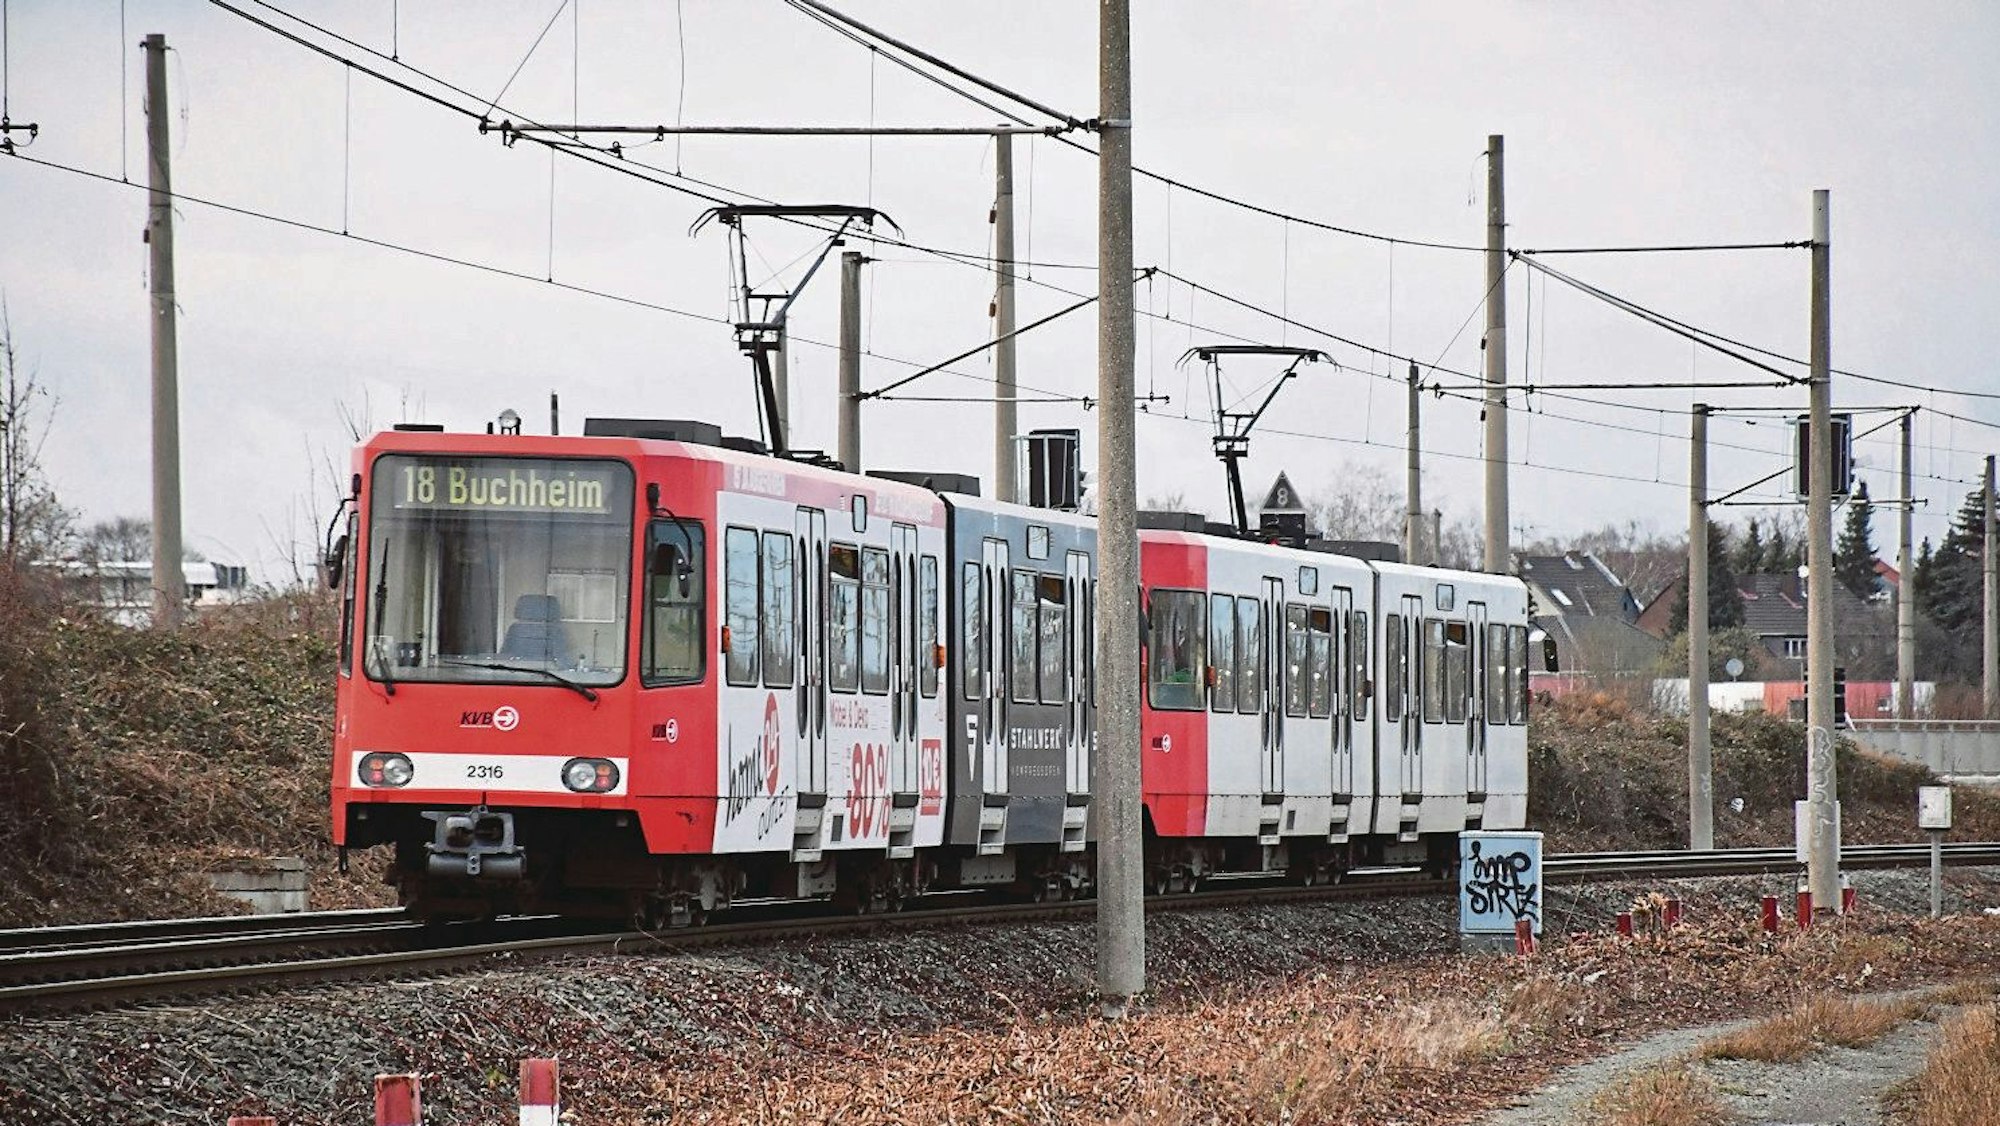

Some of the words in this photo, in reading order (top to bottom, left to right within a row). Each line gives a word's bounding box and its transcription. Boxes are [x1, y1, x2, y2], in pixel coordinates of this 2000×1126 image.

[403, 465, 435, 504] 18
[449, 466, 603, 509] Buchheim
[1276, 487, 1289, 505] 8
[460, 711, 494, 725] KVB
[1010, 726, 1062, 750] STAHLWERK
[467, 765, 503, 779] 2316
